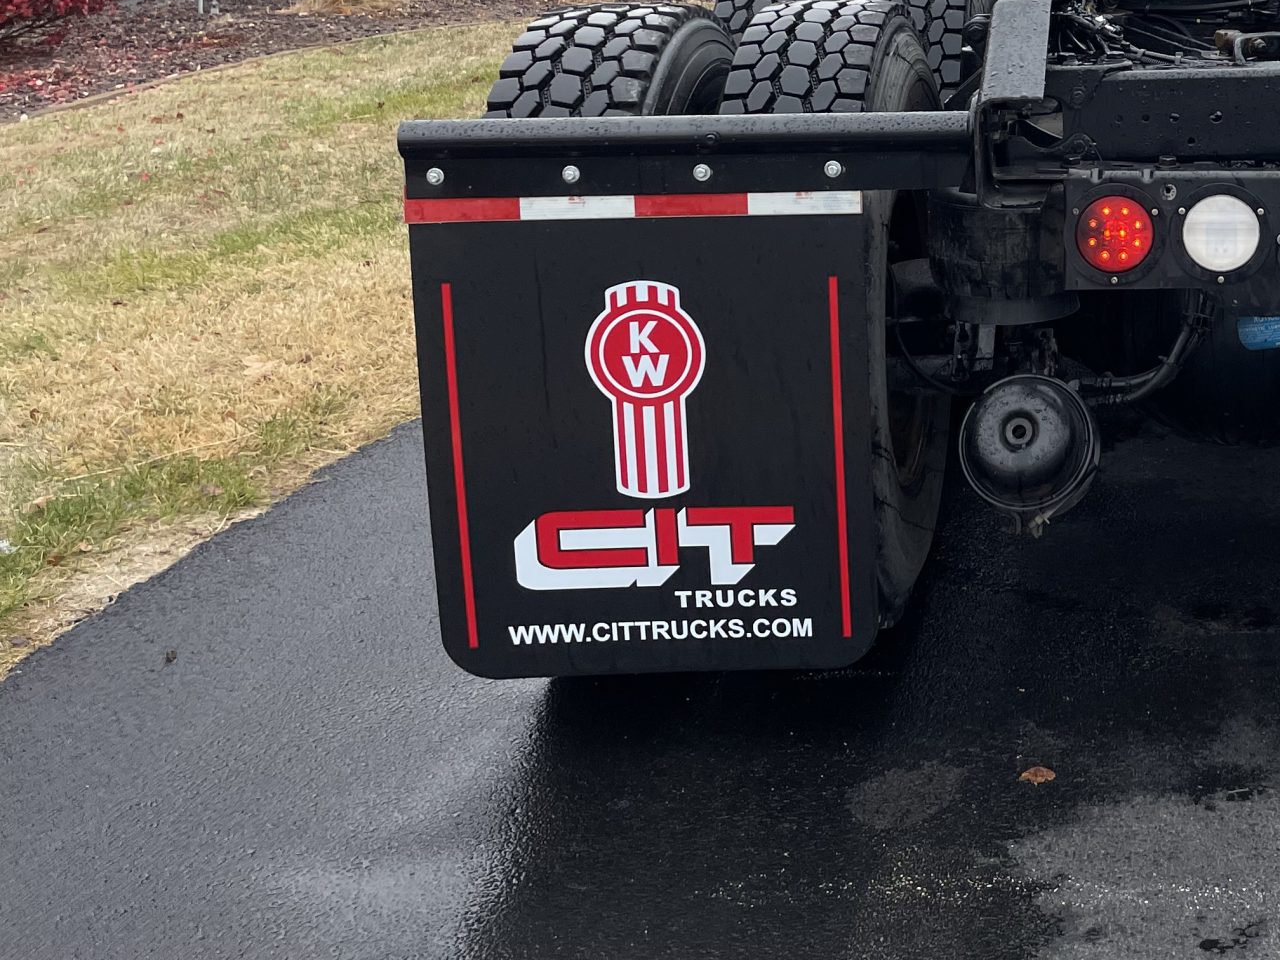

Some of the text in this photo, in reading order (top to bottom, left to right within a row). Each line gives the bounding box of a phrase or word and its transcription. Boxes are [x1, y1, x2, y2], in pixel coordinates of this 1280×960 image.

[514, 506, 796, 591] CIT
[674, 588, 798, 608] TRUCKS
[508, 617, 813, 646] WWW.CITTRUCKS.COM
